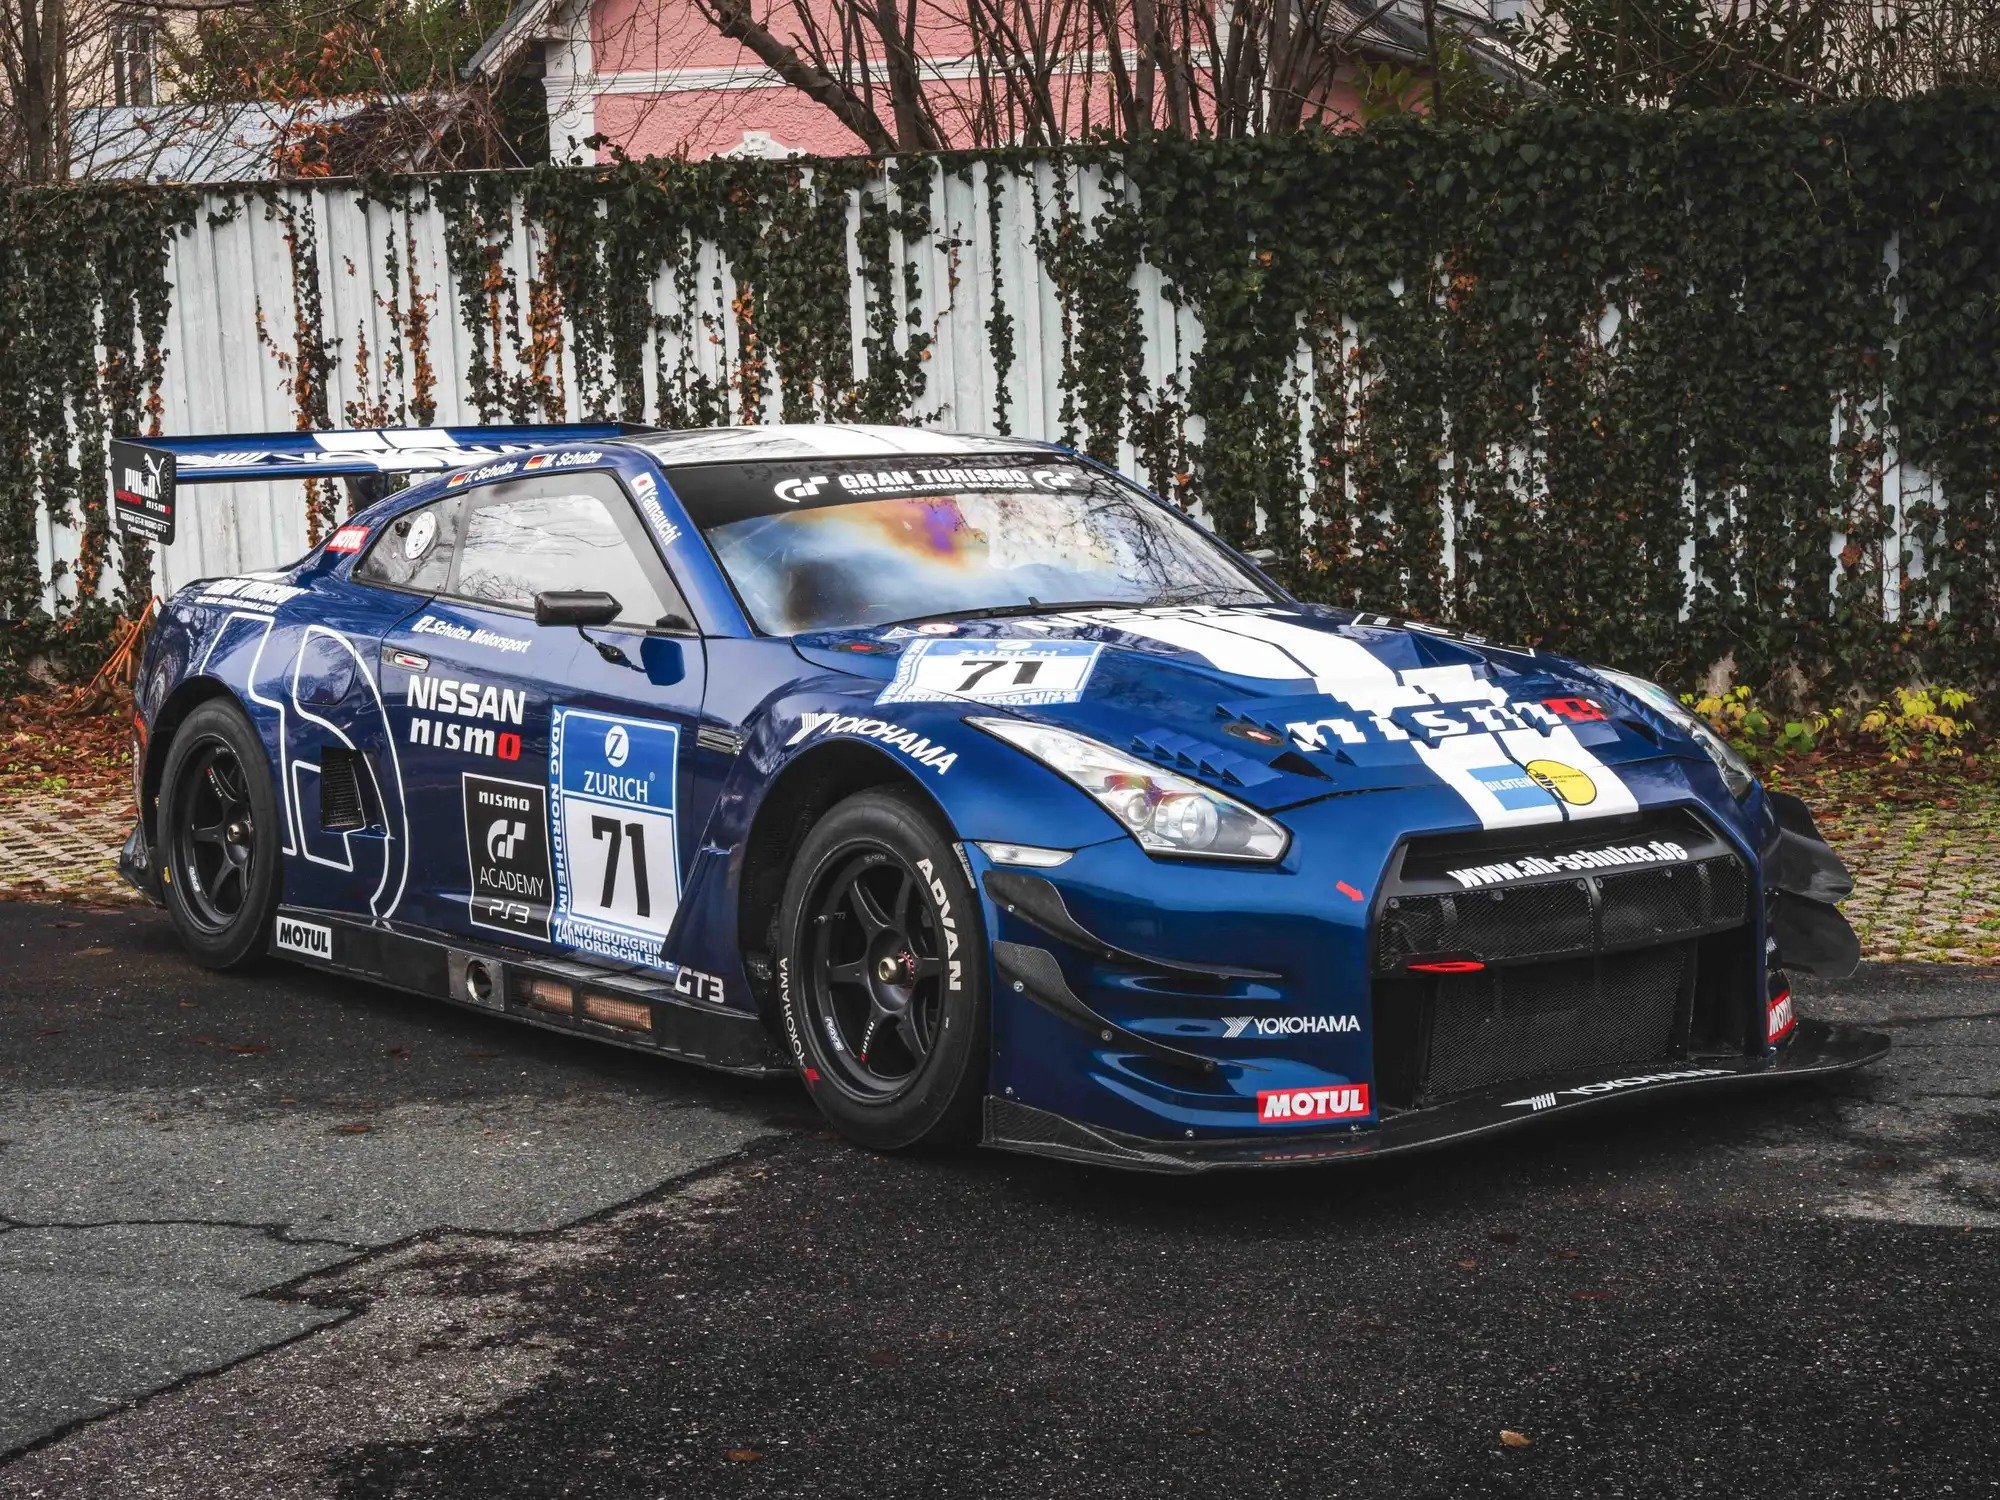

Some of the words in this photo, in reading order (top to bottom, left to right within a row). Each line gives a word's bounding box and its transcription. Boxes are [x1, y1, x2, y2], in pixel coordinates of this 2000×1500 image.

[838, 471, 915, 489] GRAN
[917, 468, 1030, 483] TURISMO
[847, 488, 877, 496] THE
[876, 485, 912, 493] REAL
[911, 482, 965, 491] DRIVING
[965, 481, 1035, 489] SIMULATOR
[640, 484, 683, 545] Yamauchi
[469, 628, 532, 654] Motorsport
[955, 660, 1044, 692] 71
[406, 674, 526, 725] NISSAN
[409, 717, 521, 761] nismo
[551, 708, 562, 776] ADAC
[821, 715, 959, 776] YOKOHAMA
[478, 790, 530, 812] nismo
[550, 785, 568, 913] NORDHEIM
[1446, 840, 1689, 889] www.ah-schulze.de
[479, 866, 544, 898] ACADEMY
[591, 814, 650, 918] 71
[488, 898, 530, 924] PS3
[915, 858, 962, 991] ADVAN
[279, 922, 329, 954] MOTUL
[555, 917, 575, 947] 24h
[574, 924, 663, 955] NÜRBURGRIN
[675, 965, 725, 1004] GT3
[780, 957, 805, 1067] YOKOHAMA
[1254, 1015, 1361, 1035] YOKOHAMA
[1556, 1068, 1737, 1095] YOKOHAMA
[1263, 1089, 1364, 1119] MOTUL
